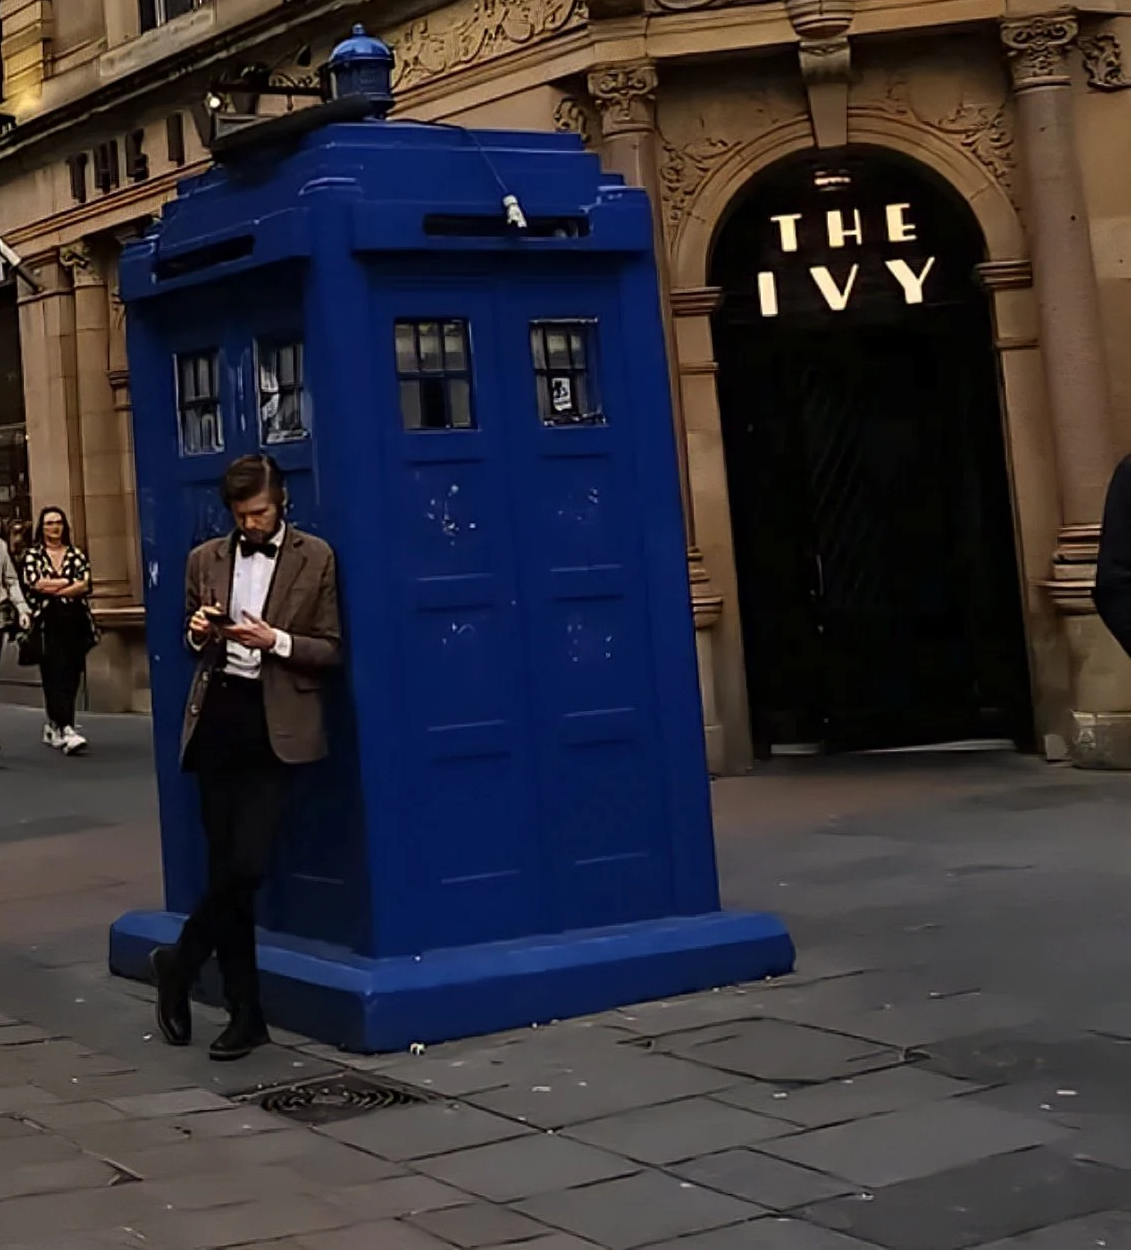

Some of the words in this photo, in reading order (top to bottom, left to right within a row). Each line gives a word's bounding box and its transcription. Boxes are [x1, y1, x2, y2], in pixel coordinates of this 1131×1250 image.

[65, 128, 150, 204] THE
[770, 203, 917, 252] THE
[758, 256, 935, 317] IVY
